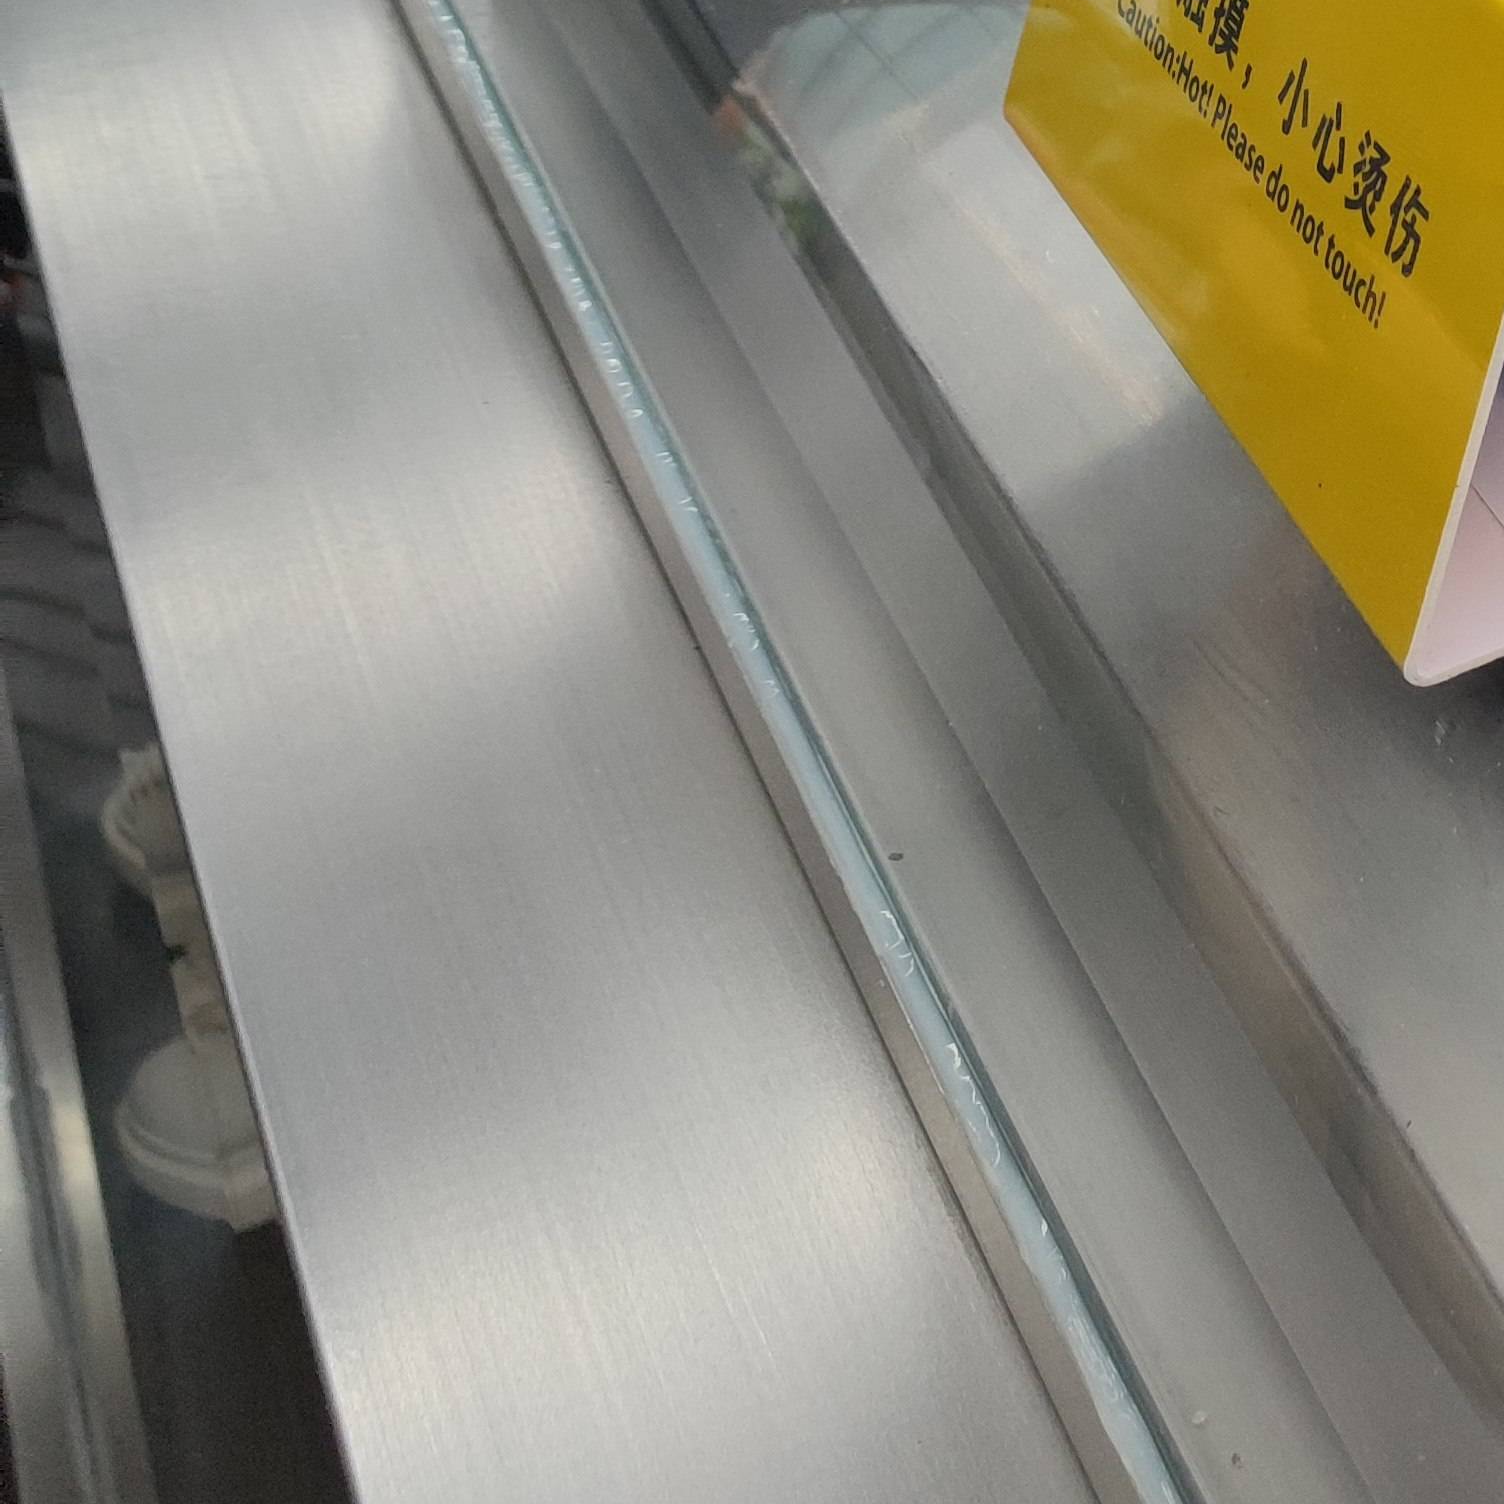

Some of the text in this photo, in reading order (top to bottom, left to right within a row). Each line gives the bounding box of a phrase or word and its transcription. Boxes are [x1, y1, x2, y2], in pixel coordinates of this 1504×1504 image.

[1211, 93, 1266, 182] Please
[1265, 163, 1291, 214] do
[1289, 196, 1325, 258] not
[1324, 230, 1387, 329] touch!
